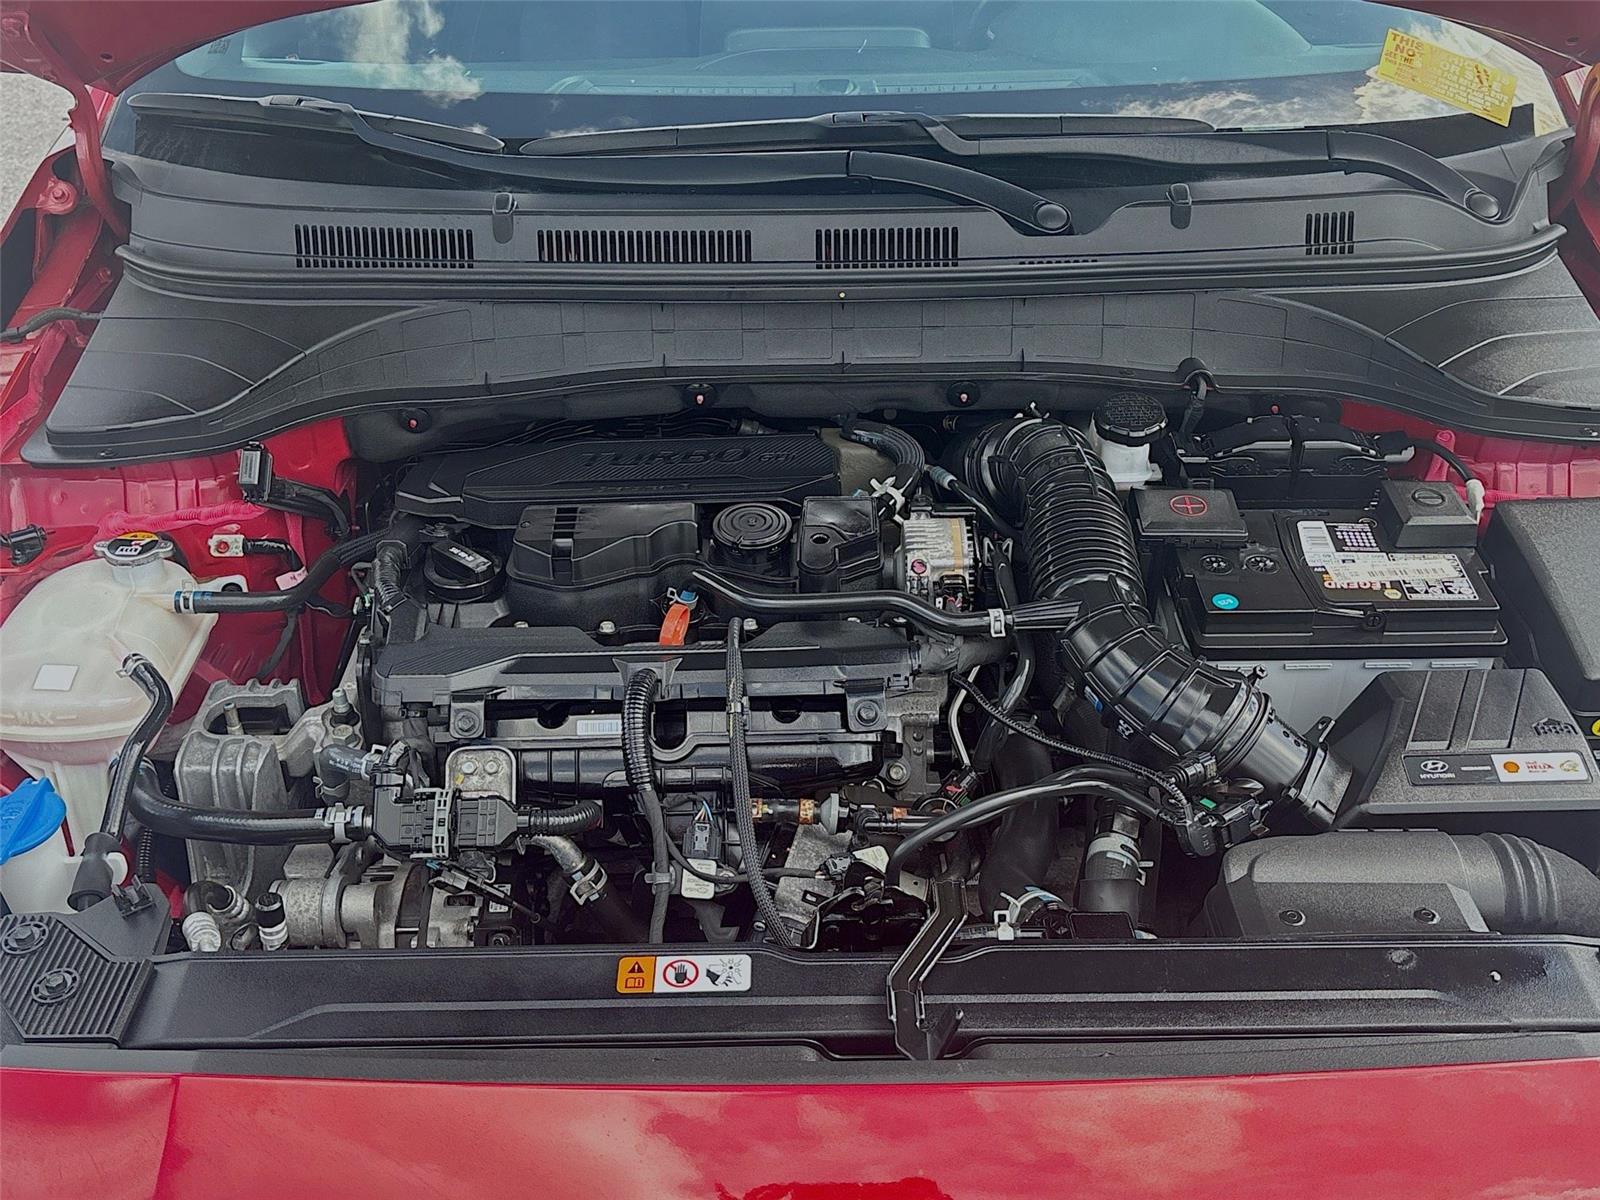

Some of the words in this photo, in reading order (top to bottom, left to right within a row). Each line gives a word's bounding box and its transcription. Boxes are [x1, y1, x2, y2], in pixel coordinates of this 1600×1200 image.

[1391, 32, 1424, 50] THIS
[581, 448, 751, 468] TURBO
[15, 711, 55, 726] MAX
